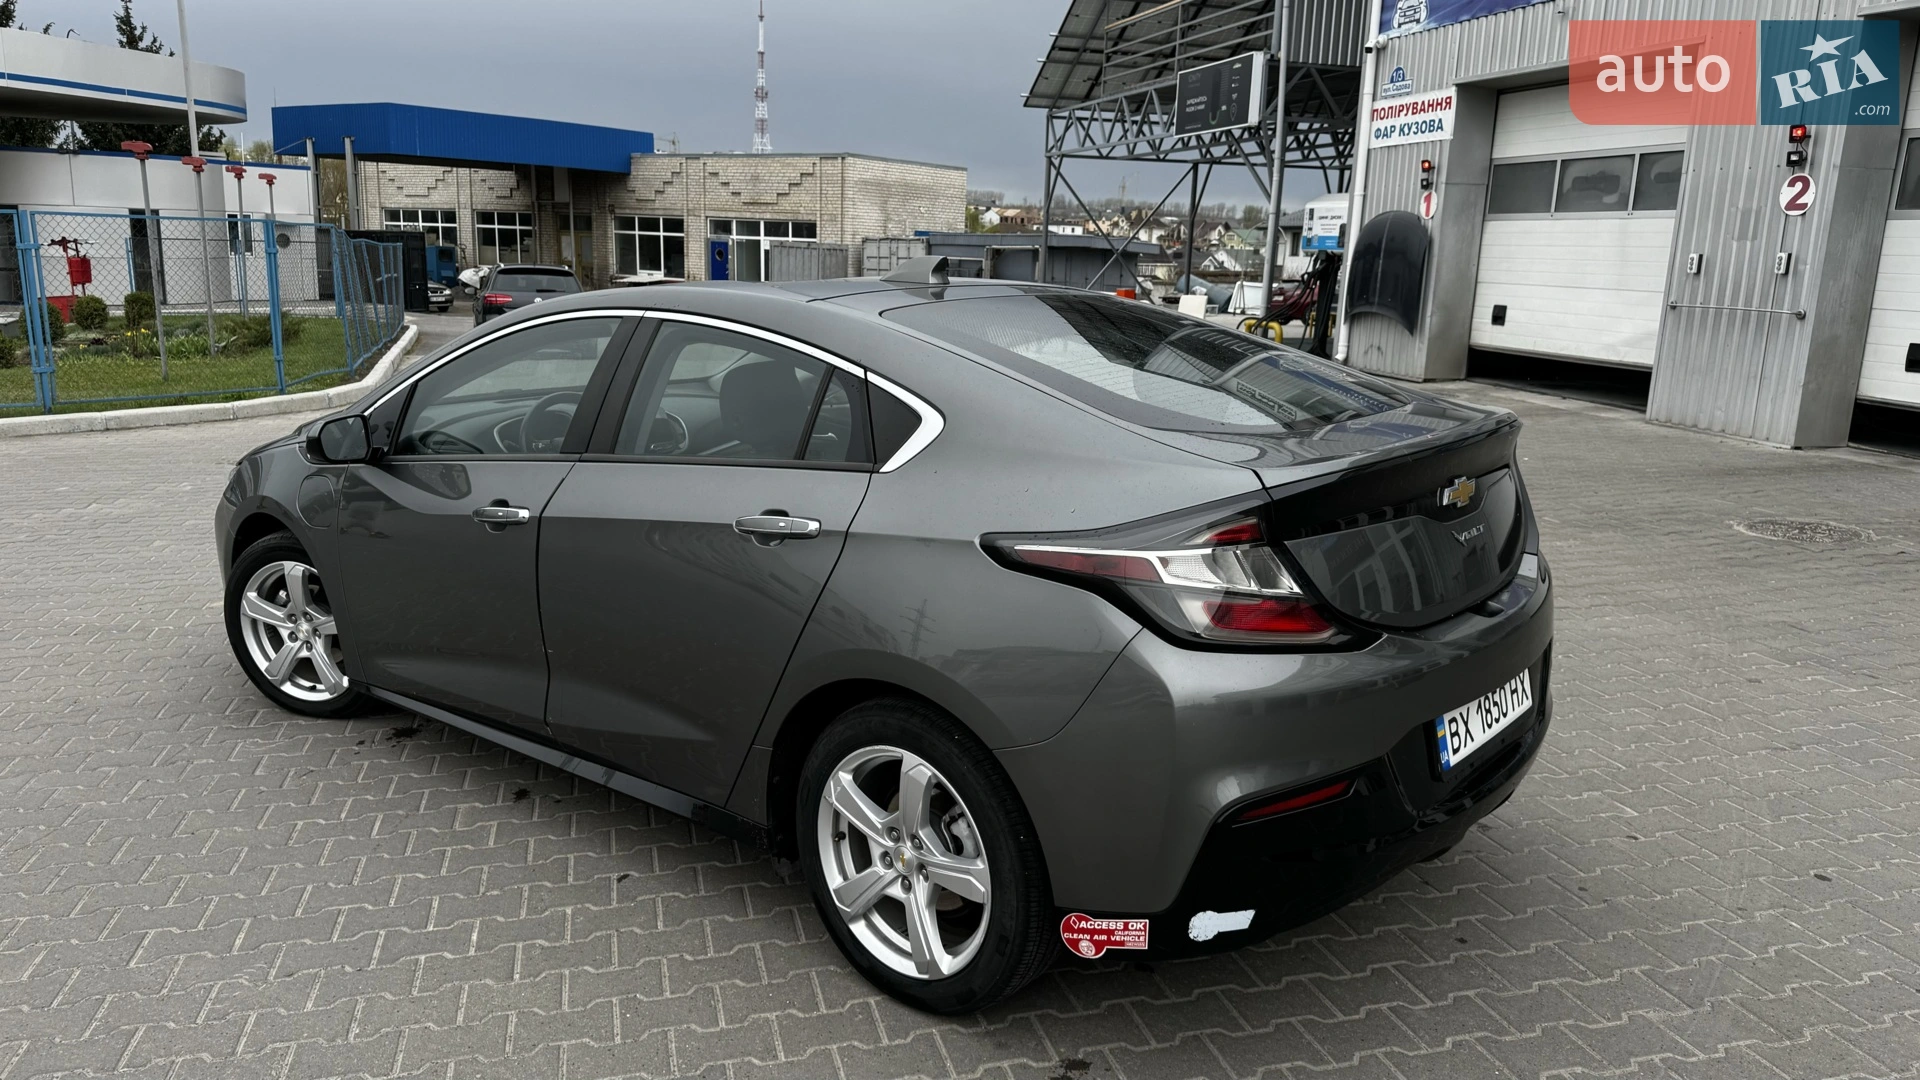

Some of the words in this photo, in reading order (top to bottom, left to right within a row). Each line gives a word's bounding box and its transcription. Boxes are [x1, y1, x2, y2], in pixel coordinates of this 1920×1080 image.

[1392, 70, 1404, 82] 1/3
[1392, 83, 1411, 92] Садова
[1371, 96, 1453, 122] ПОЛІРУВАННЯ
[1374, 125, 1396, 140] ФАР
[1398, 118, 1444, 137] КУЗОВА
[1784, 175, 1811, 211] 2
[1424, 191, 1432, 218] 1
[1448, 706, 1475, 756] BX
[1476, 686, 1509, 735] 1850
[1509, 671, 1529, 712] HX
[1440, 749, 1449, 764] UA
[1079, 920, 1124, 930] ACCESS
[1128, 922, 1145, 930] OK
[1063, 932, 1091, 940] CLEAN
